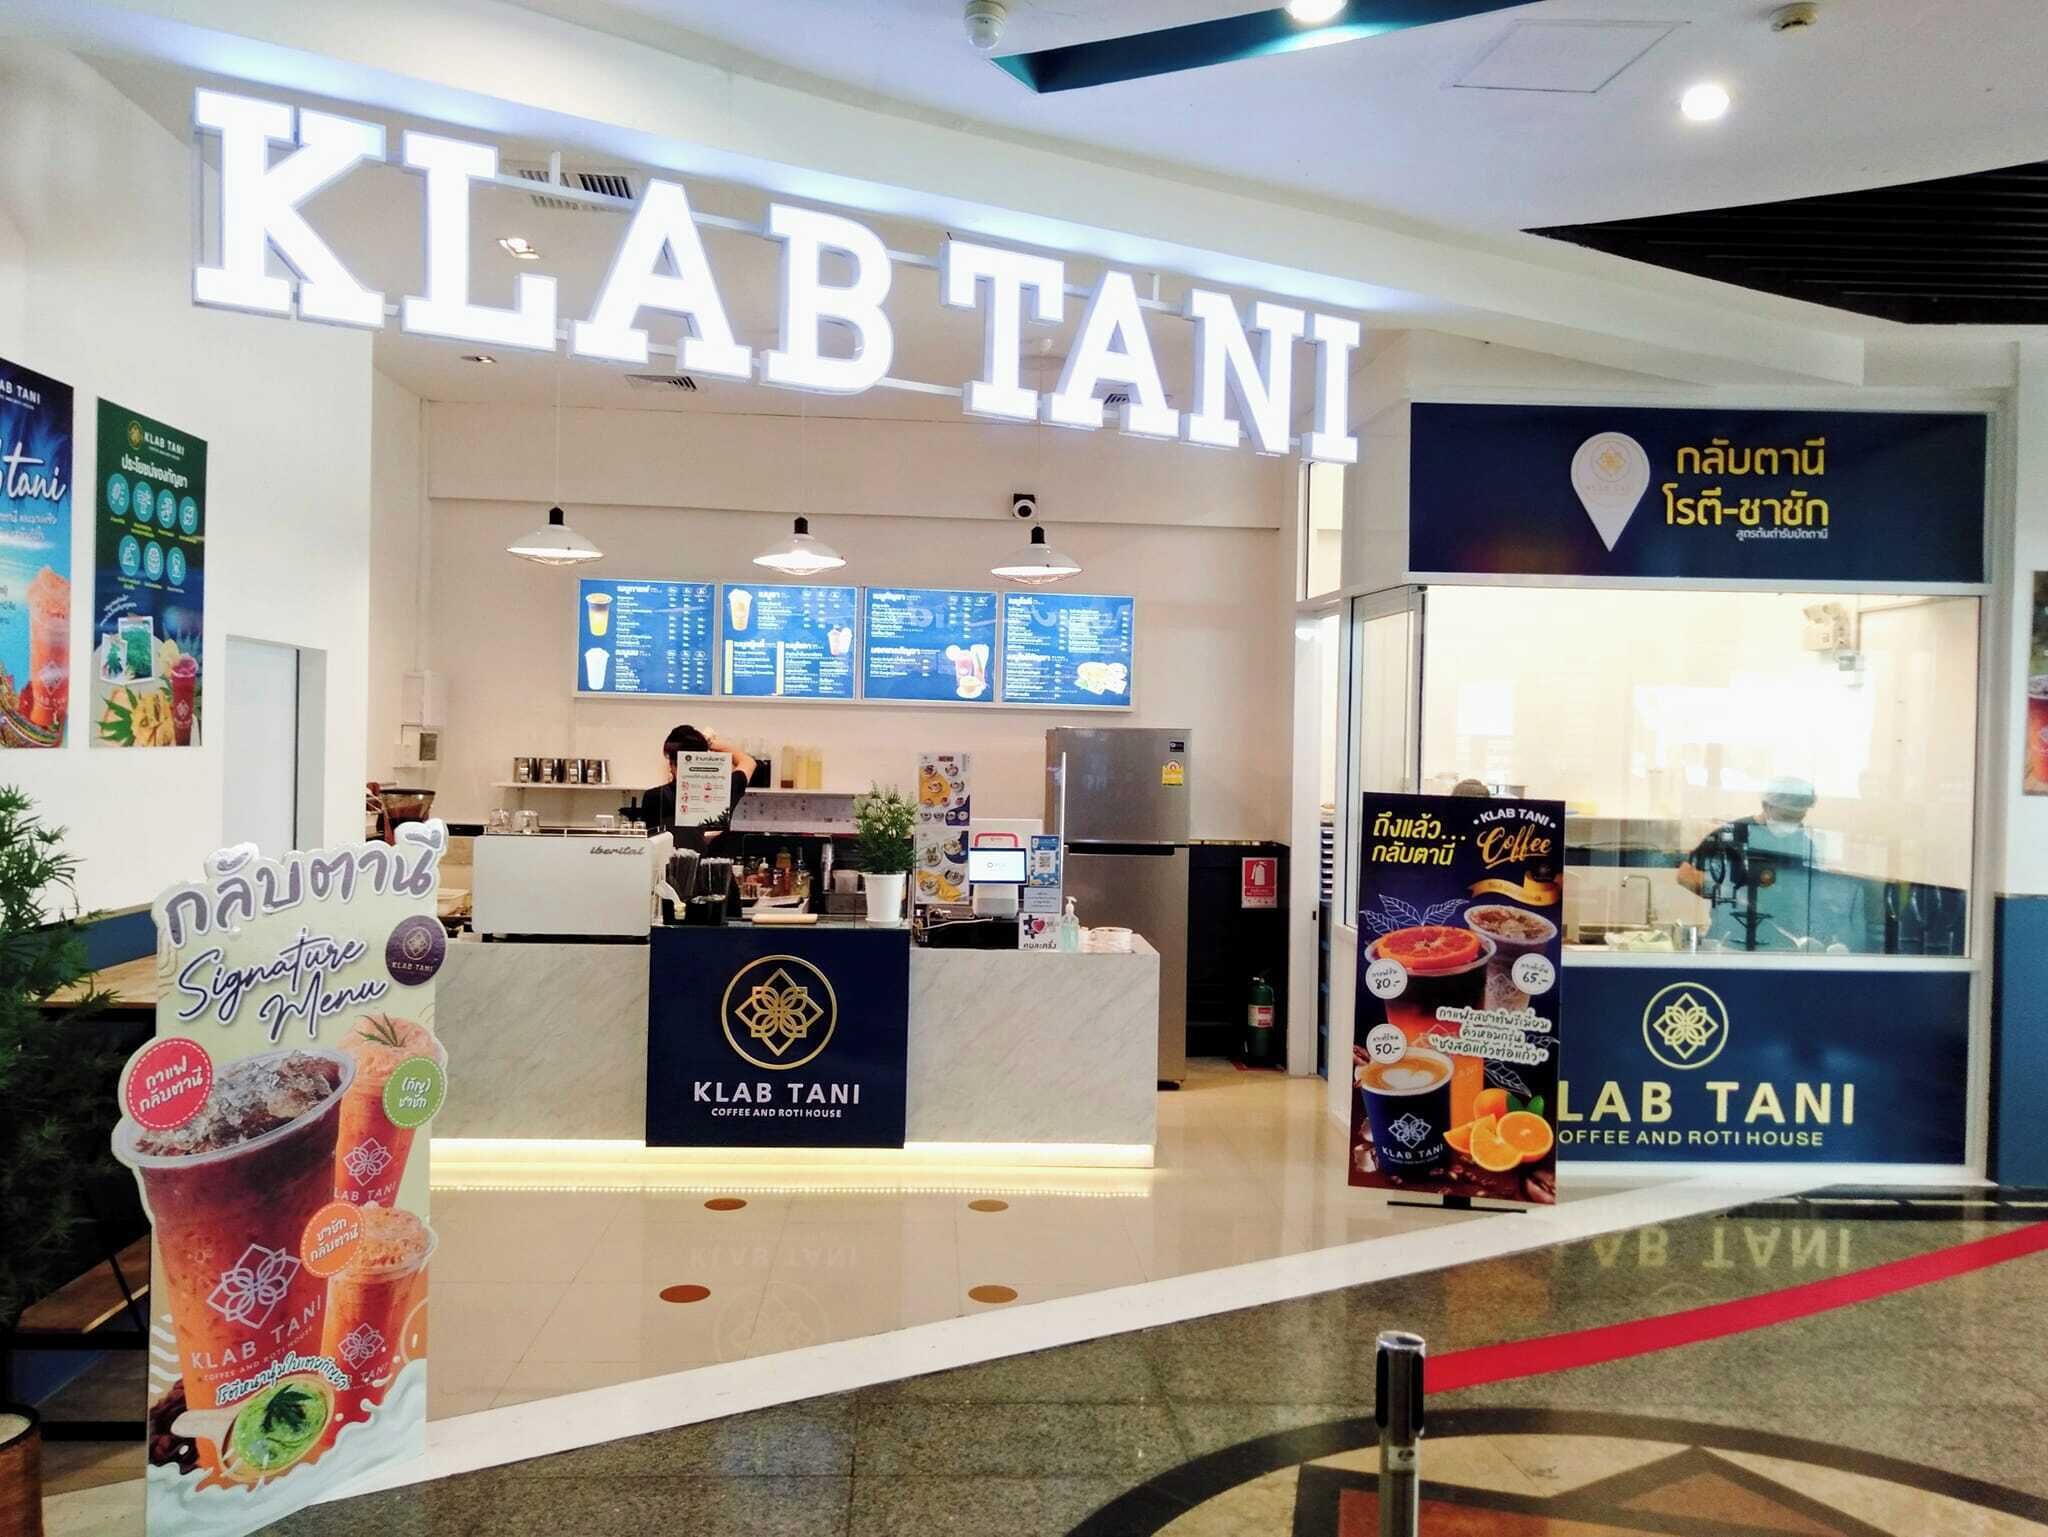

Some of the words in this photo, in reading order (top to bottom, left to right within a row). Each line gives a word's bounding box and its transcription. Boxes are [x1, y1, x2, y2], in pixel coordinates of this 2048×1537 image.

[191, 87, 895, 394] KLAB
[938, 238, 1361, 465] TANI
[17, 385, 41, 405] TANI
[144, 431, 165, 448] KLAB
[167, 441, 185, 456] TANI
[1677, 437, 1826, 477] กลับตานี
[1661, 483, 1829, 527] โรตี-ชาชัก
[1480, 808, 1516, 823] KLAB
[1518, 808, 1549, 827] TANI
[1371, 841, 1456, 866] กลับตานี
[1476, 824, 1553, 868] Coffee
[163, 829, 443, 946] กลับตานี
[177, 928, 365, 1021] Signature
[391, 961, 412, 970] KLAB
[258, 969, 388, 1041] Menu
[140, 1065, 204, 1113] กลับตานี
[146, 1055, 187, 1090] กาแฟ
[693, 1081, 773, 1104] KLAB
[787, 1083, 860, 1105] TANI
[1558, 1080, 1673, 1123] LAB
[1705, 1081, 1856, 1126] TANI
[711, 1107, 751, 1117] COFFEE
[752, 1108, 776, 1117] AND
[778, 1108, 803, 1118] ROTI
[805, 1109, 842, 1118] HOUSE
[1381, 1146, 1412, 1160] KLAB
[1418, 1143, 1444, 1159] TANI
[1558, 1129, 1631, 1145] OFFEE
[1636, 1130, 1683, 1146] AND
[1688, 1131, 1740, 1146] ROTI
[1746, 1131, 1824, 1147] HOUSE
[334, 1187, 360, 1201] LAB
[367, 1181, 397, 1201] TANI
[311, 1223, 360, 1263] กลับตานี
[191, 1341, 257, 1369] KLAB
[271, 1295, 321, 1344] TANI
[239, 1360, 260, 1373] AND
